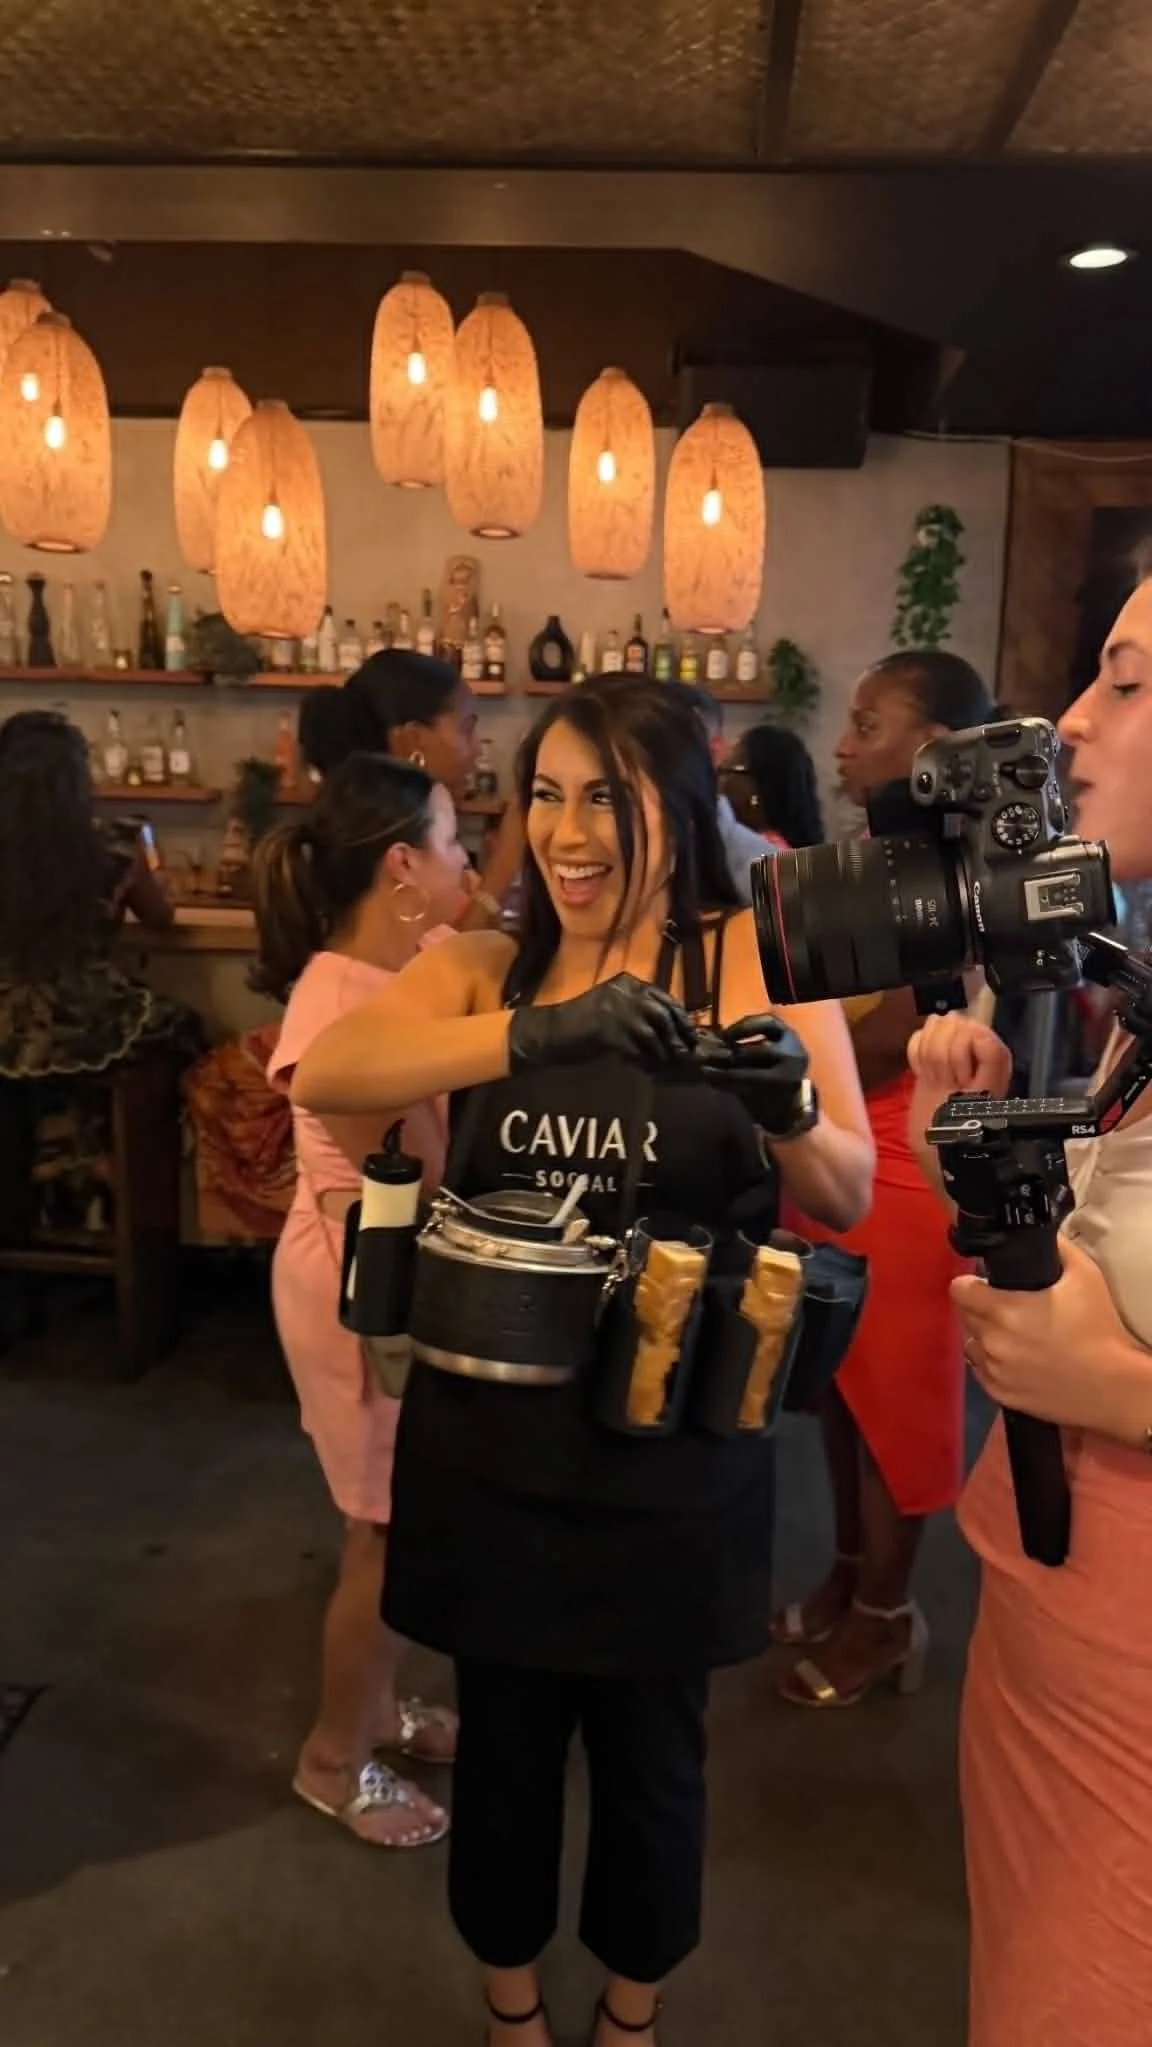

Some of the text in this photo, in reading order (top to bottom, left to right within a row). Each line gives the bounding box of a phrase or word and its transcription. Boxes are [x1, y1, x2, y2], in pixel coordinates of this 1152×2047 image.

[974, 881, 985, 932] Canon
[500, 1109, 658, 1162] CAVIAR
[536, 1169, 617, 1193] SOCAL
